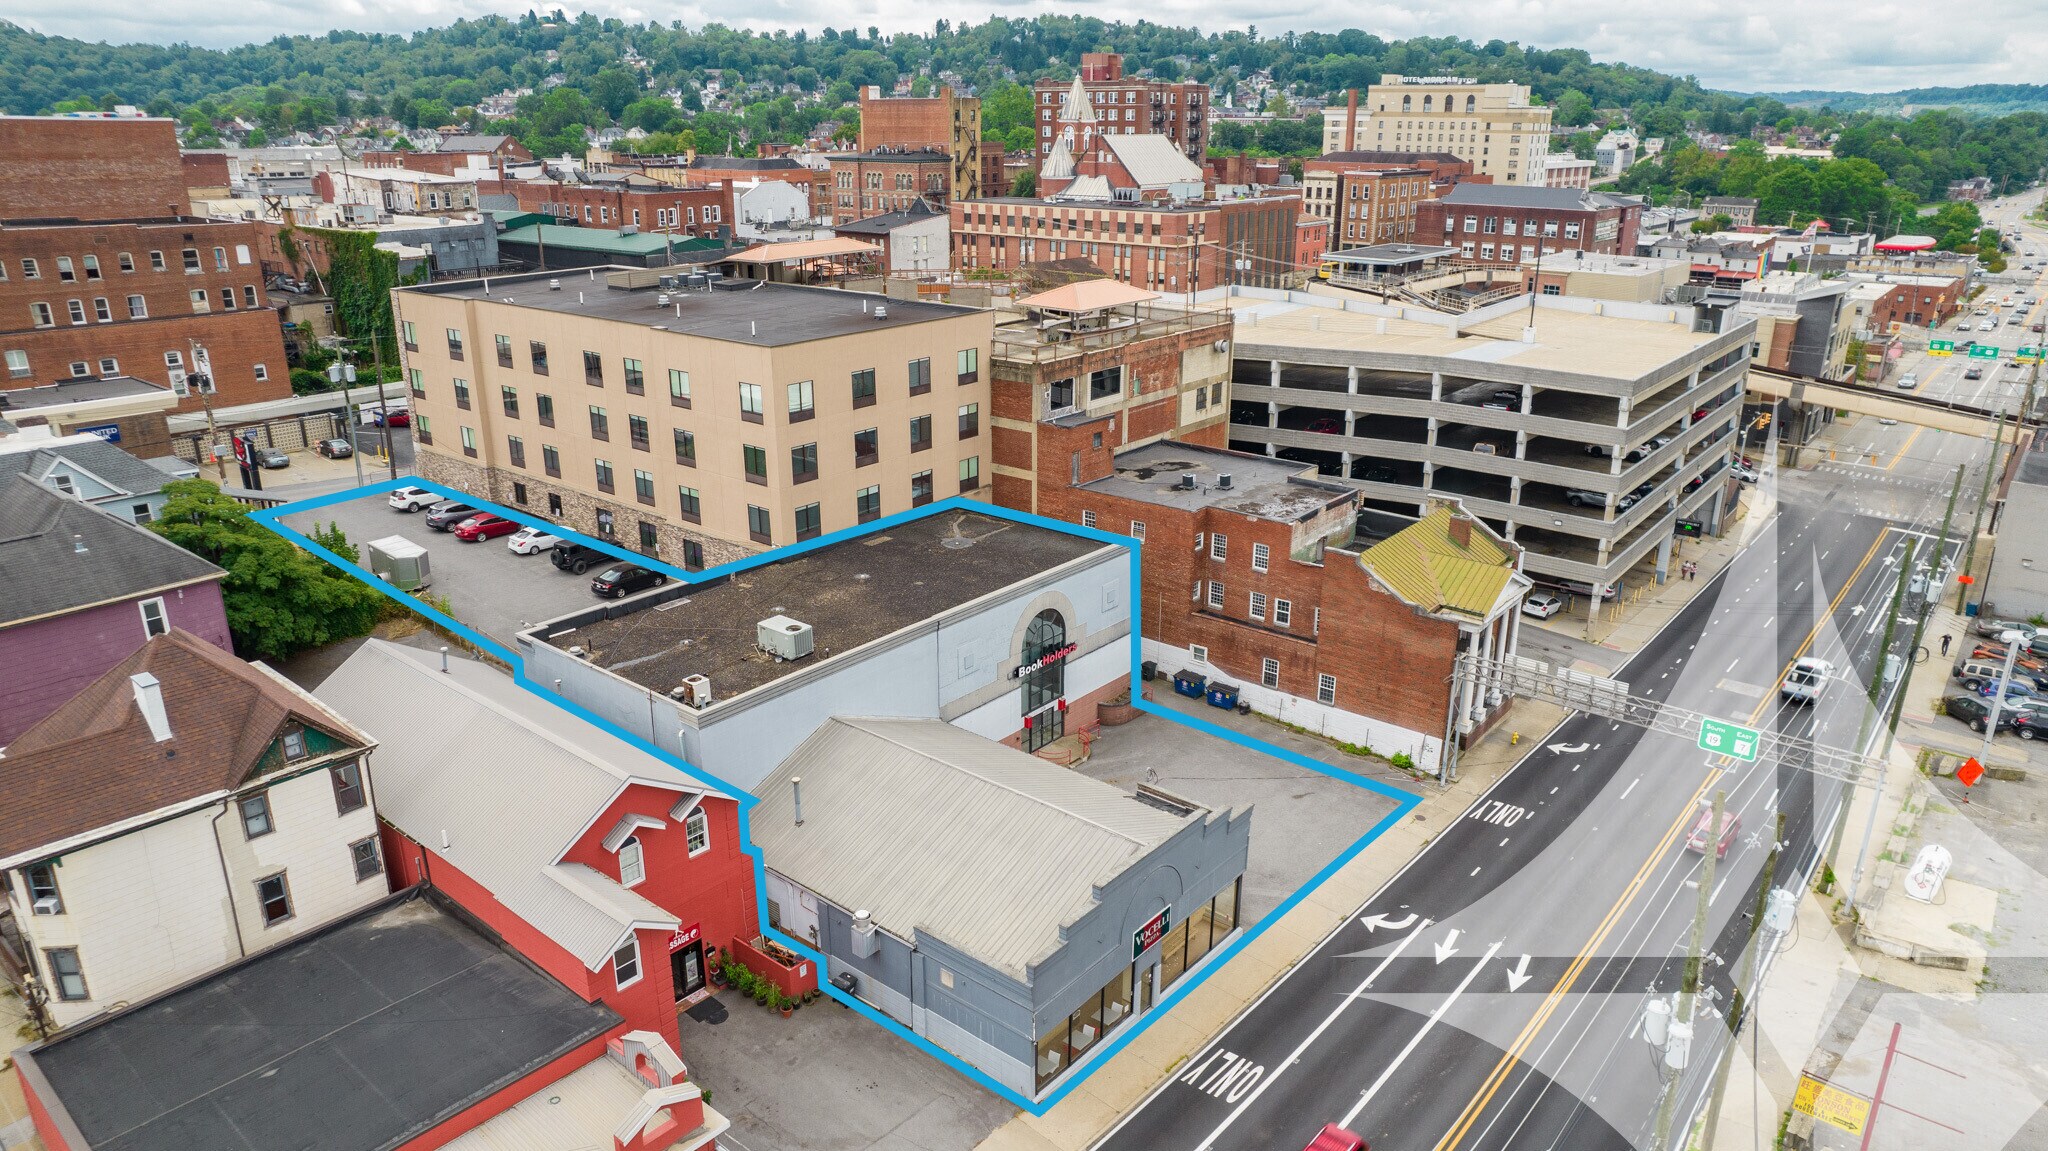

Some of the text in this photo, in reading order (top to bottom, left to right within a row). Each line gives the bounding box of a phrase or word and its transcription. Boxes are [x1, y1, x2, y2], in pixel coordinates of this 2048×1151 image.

[90, 427, 118, 437] NITED
[1469, 800, 1525, 827] ONLY
[669, 932, 690, 950] SSAGE
[1135, 912, 1170, 946] VOCELLI
[1180, 1048, 1265, 1104] ONLY
